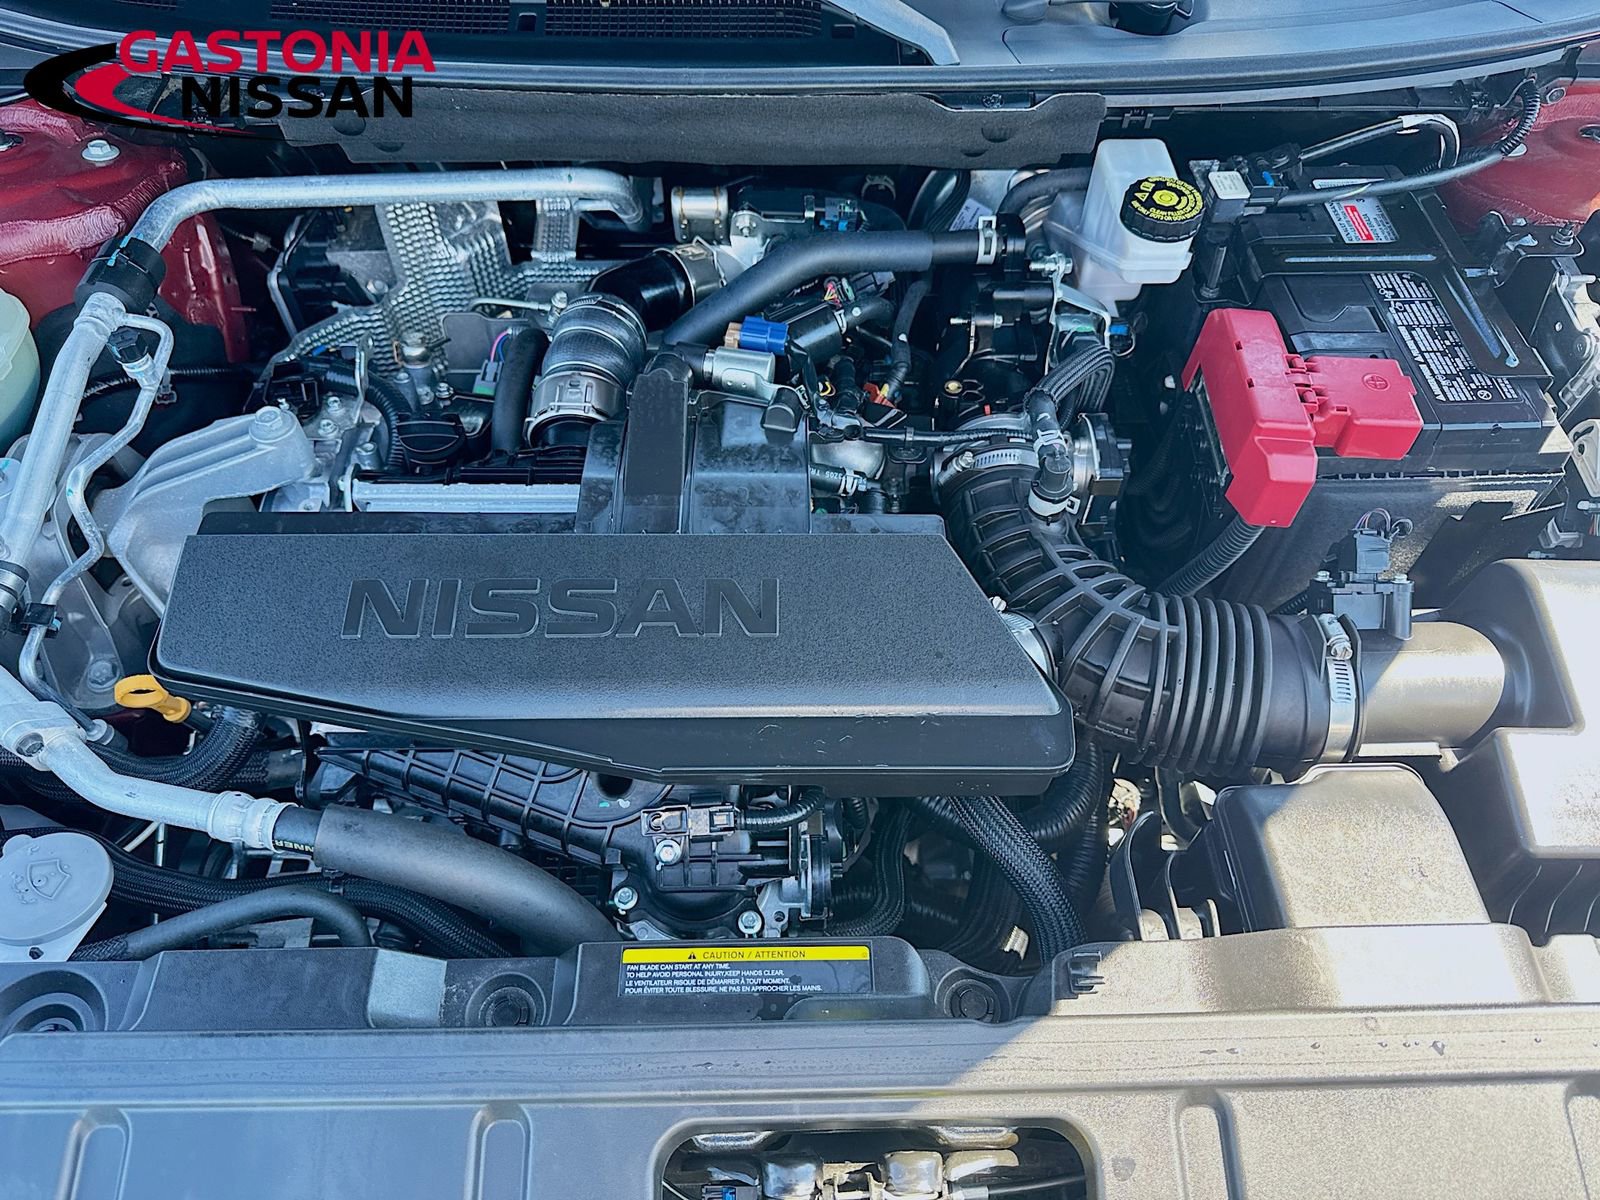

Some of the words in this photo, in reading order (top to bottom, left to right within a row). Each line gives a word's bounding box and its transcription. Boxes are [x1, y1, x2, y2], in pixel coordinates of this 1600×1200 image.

[1149, 207, 1167, 216] CLEAN
[341, 578, 780, 640] NISSAN
[702, 951, 745, 959] CAUTION
[747, 951, 752, 959] /
[754, 950, 806, 958] ATTENTION
[671, 970, 703, 978] PERSONAL
[741, 969, 763, 977] HANDS
[634, 979, 673, 987] VENTILATEUR
[706, 977, 740, 985] DÉMARRER
[643, 986, 664, 994] ÉVITER
